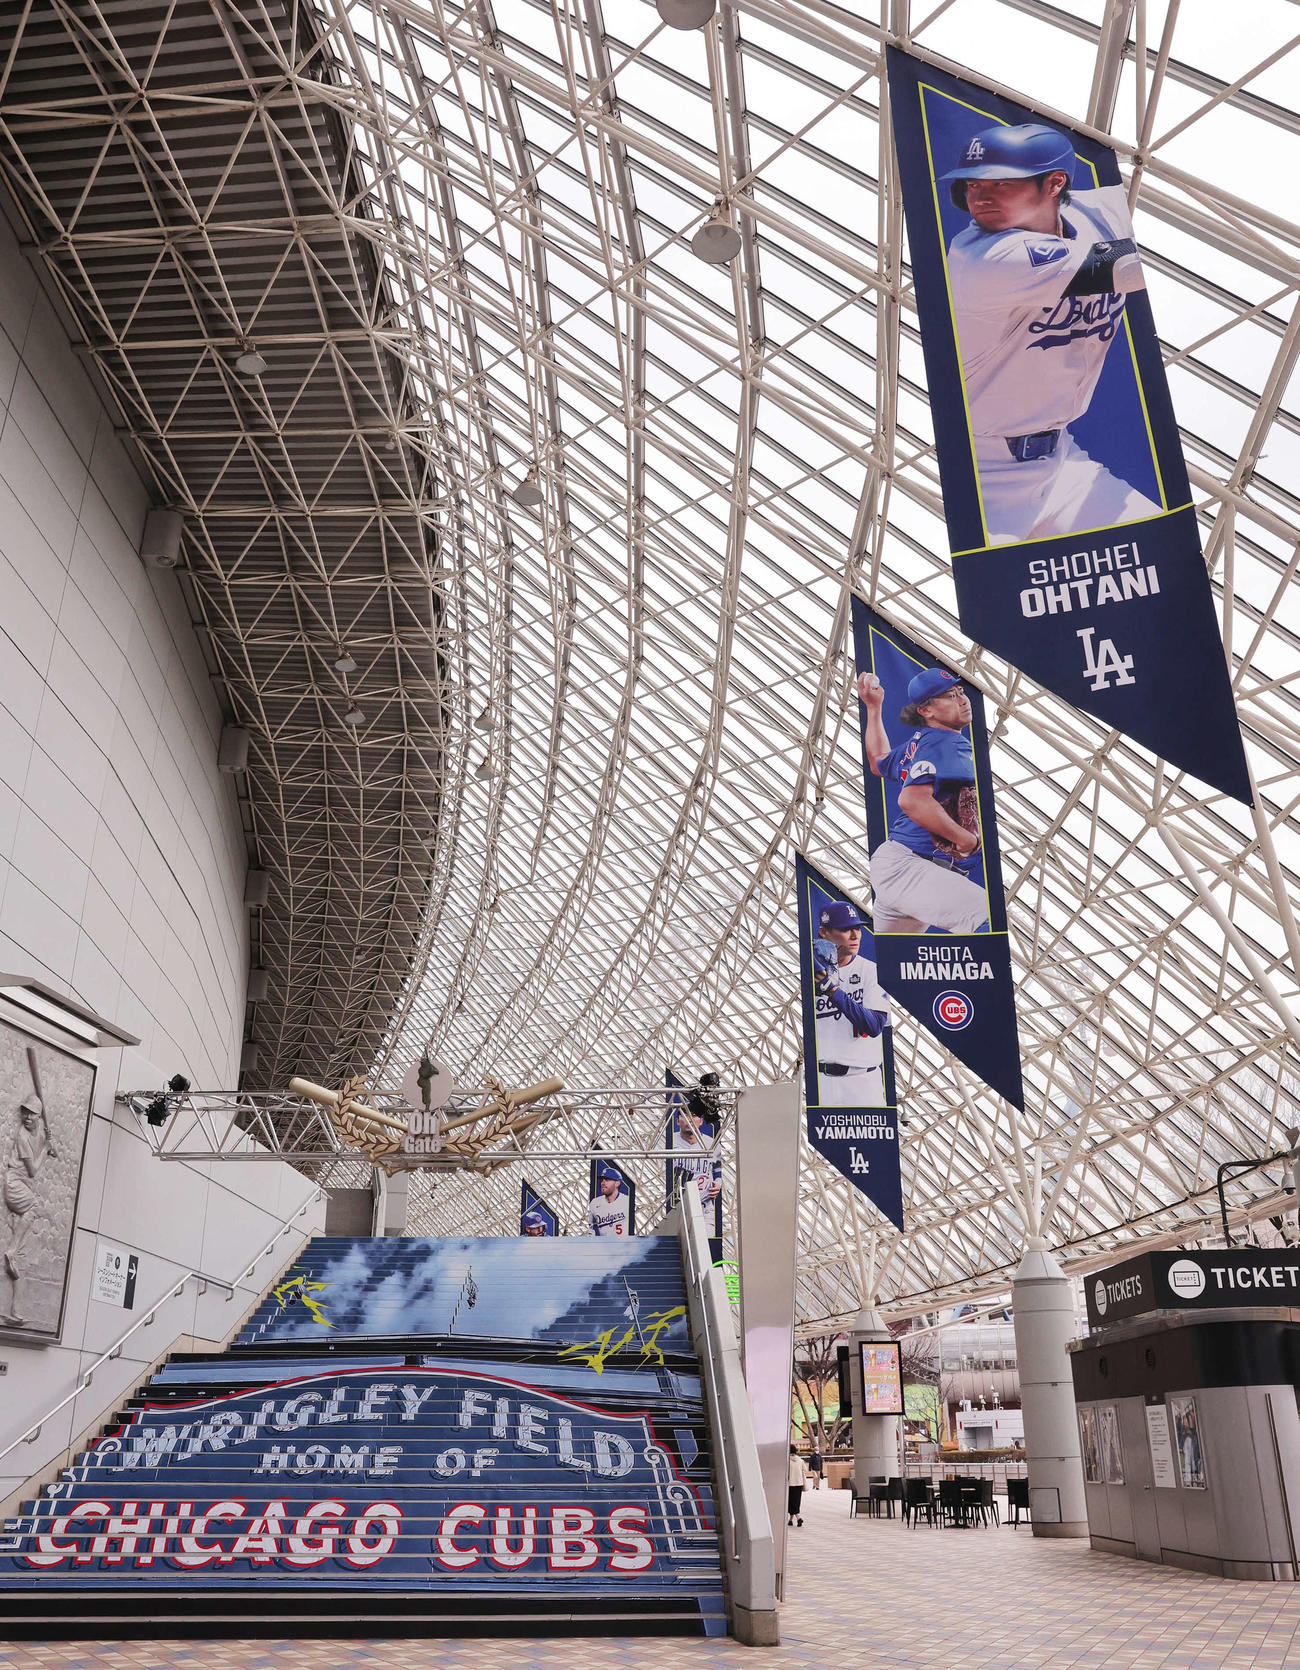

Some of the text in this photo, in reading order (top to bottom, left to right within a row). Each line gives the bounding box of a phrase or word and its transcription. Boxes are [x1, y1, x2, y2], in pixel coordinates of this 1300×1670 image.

[1028, 542, 1141, 585] SHOHEI
[1019, 565, 1161, 618] OHTANI
[1076, 627, 1136, 692] LA
[917, 946, 974, 962] SHOTA
[900, 961, 995, 981] IMANAGA
[409, 1110, 437, 1135] Oh
[815, 1126, 895, 1140] YAMAMOTO
[821, 1114, 887, 1127] YOSHINOBU
[404, 1135, 442, 1154] Gate
[849, 1146, 869, 1174] LA
[615, 1223, 623, 1235] 5
[1106, 1274, 1142, 1304] TICKETS
[112, 1383, 635, 1478] WRIGLEY FIELD
[257, 1445, 500, 1477] HOME OF
[24, 1496, 655, 1572] CHICAGO CUBS
